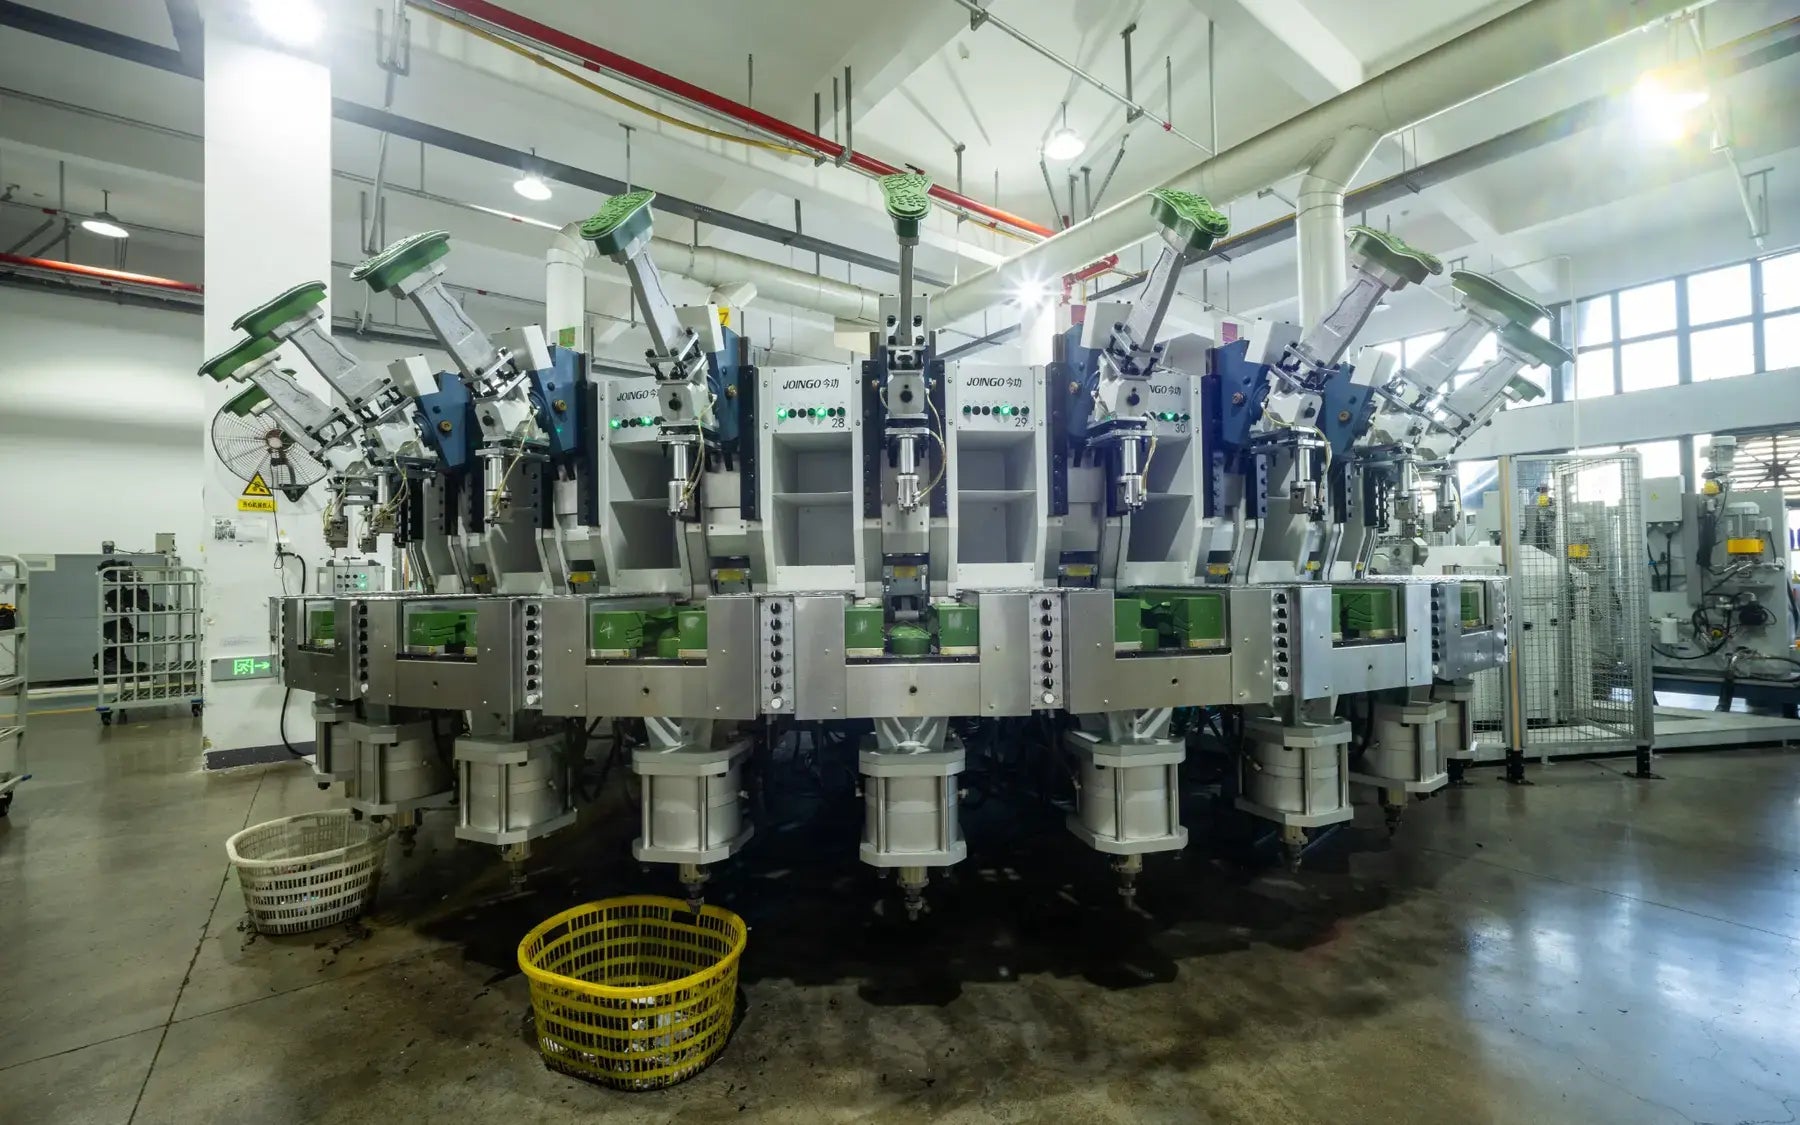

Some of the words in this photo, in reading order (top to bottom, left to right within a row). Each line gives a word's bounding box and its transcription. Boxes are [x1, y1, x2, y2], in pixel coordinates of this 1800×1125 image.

[782, 379, 822, 390] JOINGO
[823, 378, 840, 389] 今功
[966, 377, 1005, 387] JOINGO
[1006, 377, 1022, 388] 今功
[1149, 384, 1168, 394] NGO
[616, 389, 649, 401] JOINGO
[831, 417, 845, 428] 28
[1014, 416, 1028, 428] 29
[1174, 423, 1186, 433] 30
